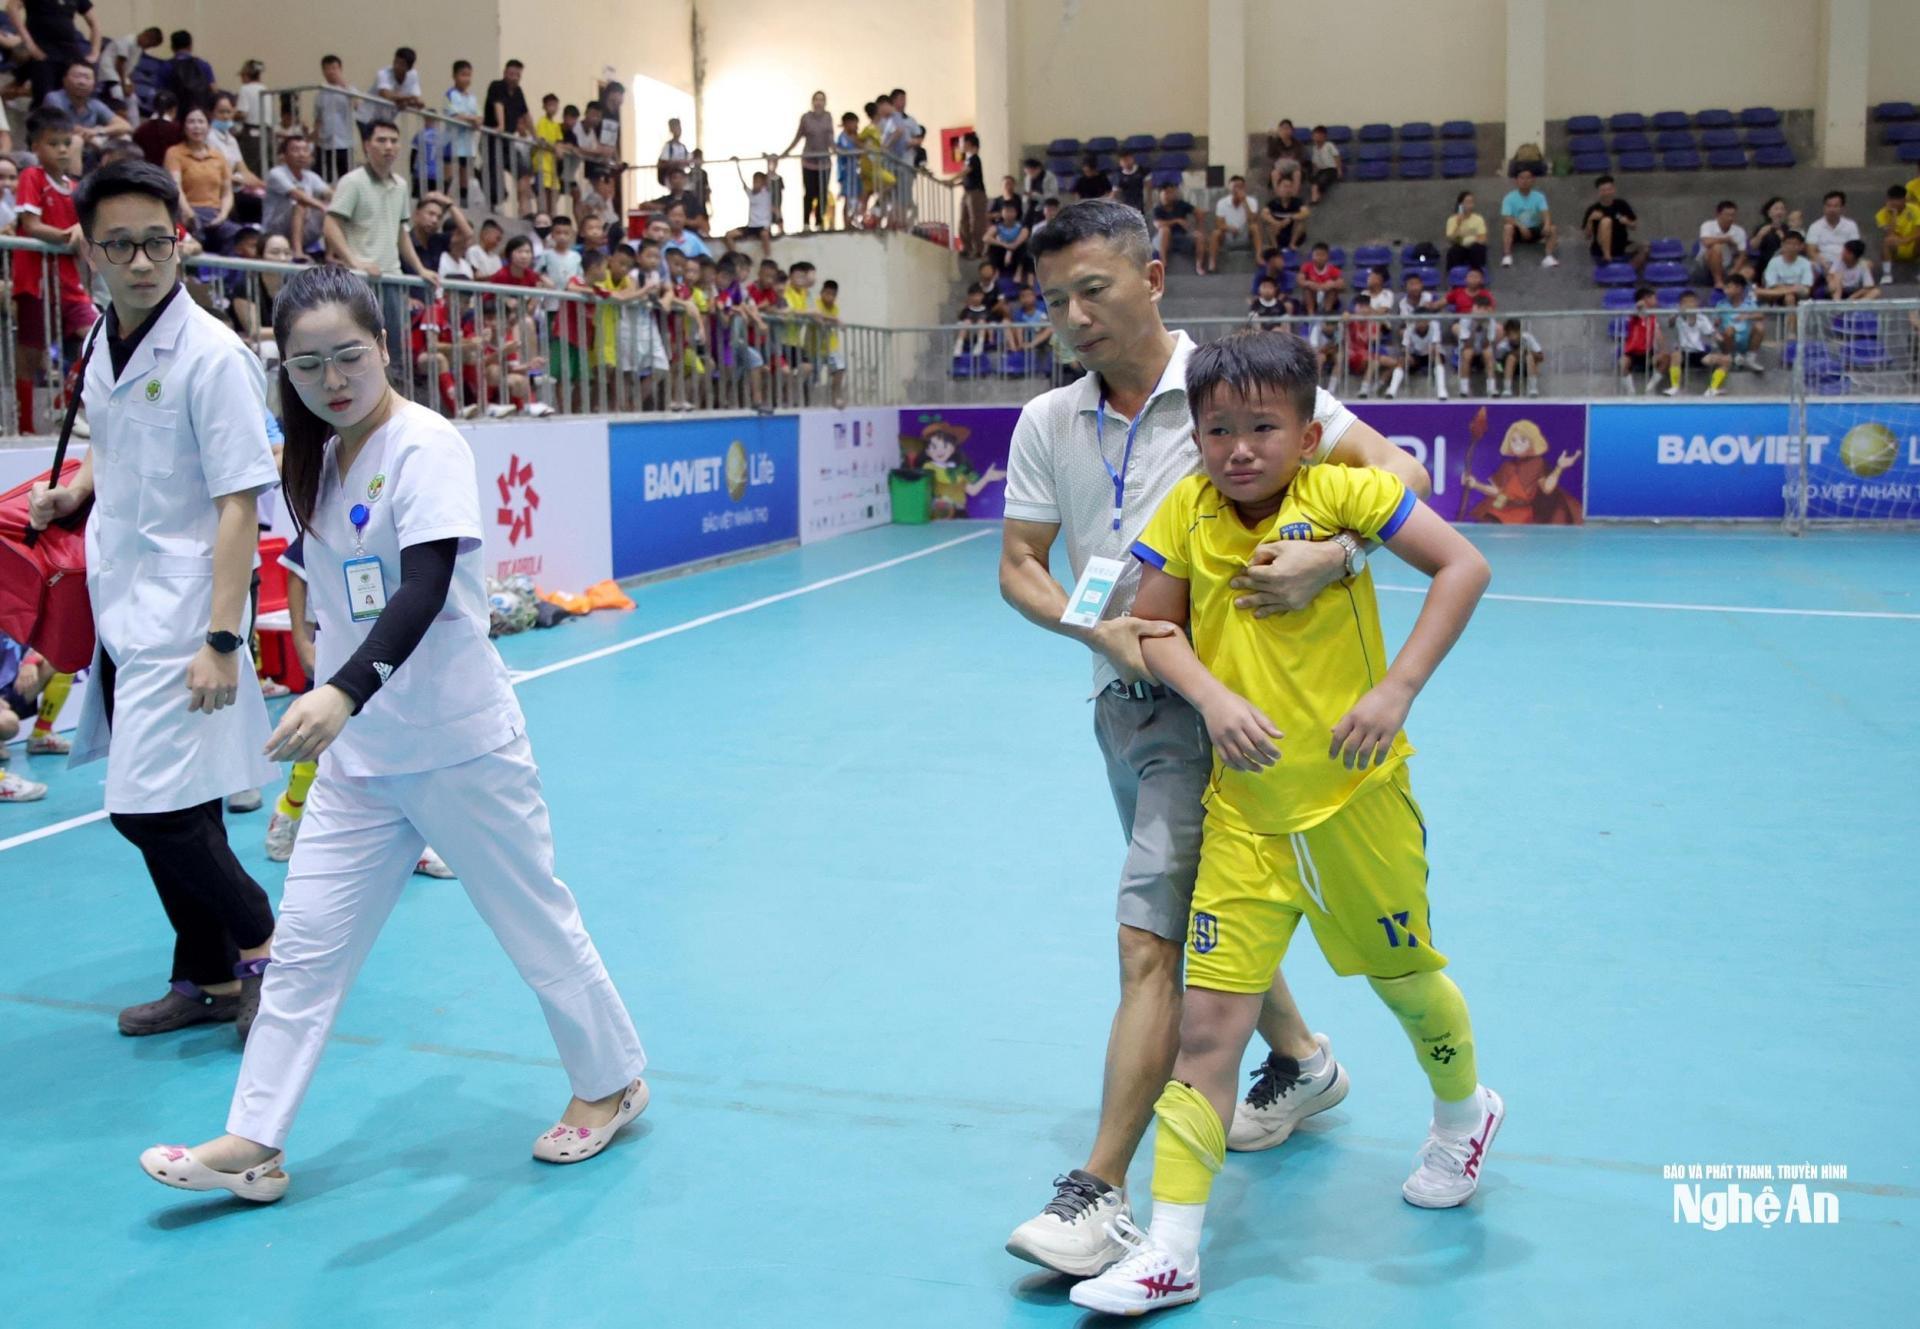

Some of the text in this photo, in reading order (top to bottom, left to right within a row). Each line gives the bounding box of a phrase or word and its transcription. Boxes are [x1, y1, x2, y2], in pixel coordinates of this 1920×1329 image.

[1657, 435, 1830, 465] BAOVIET
[644, 456, 722, 502] BAOVIET
[750, 452, 775, 486] Life
[1376, 910, 1419, 948] 17
